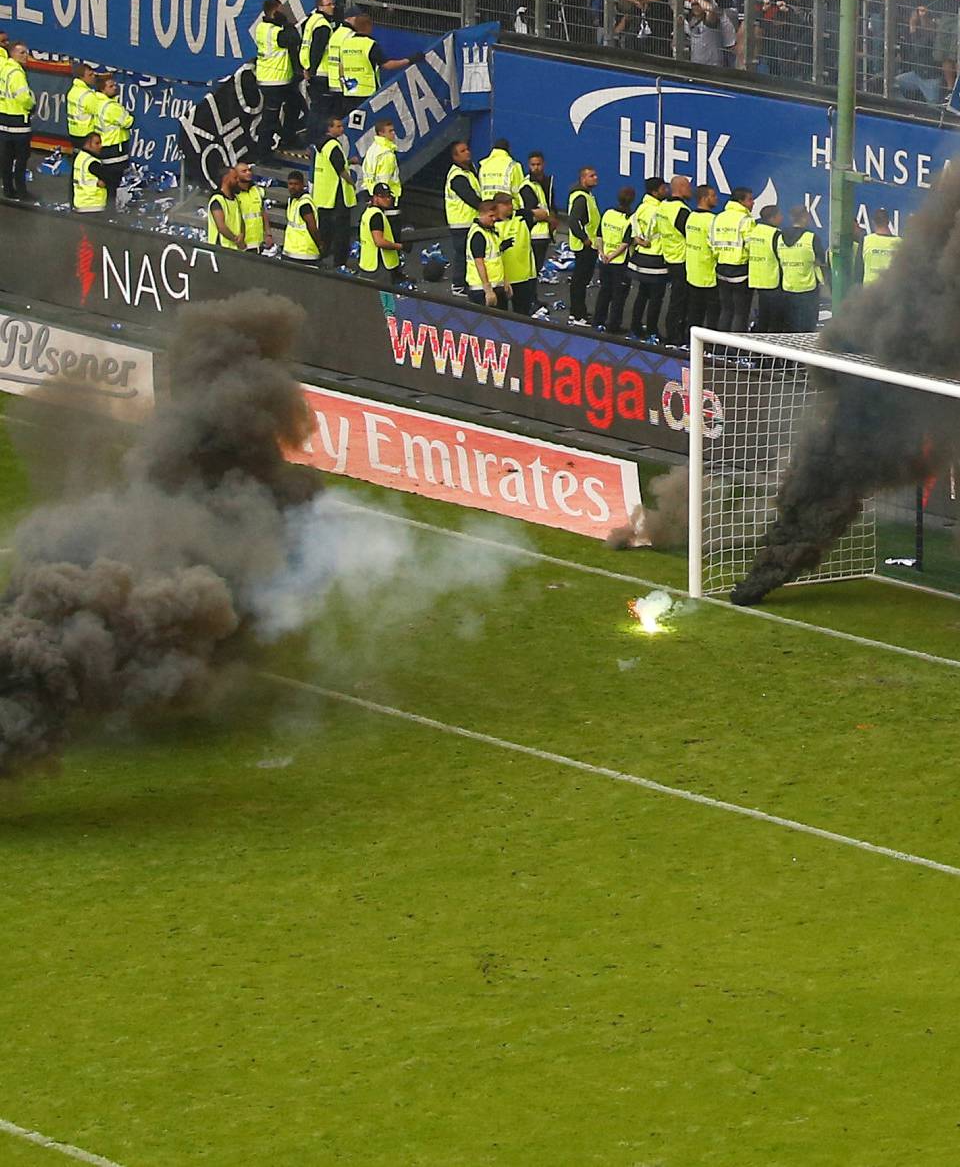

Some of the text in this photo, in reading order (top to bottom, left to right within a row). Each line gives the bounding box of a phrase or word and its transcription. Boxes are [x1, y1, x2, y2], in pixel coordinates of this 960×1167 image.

[619, 116, 731, 195] HEK
[0, 317, 137, 387] Pilsener
[362, 410, 611, 523] Emirates
